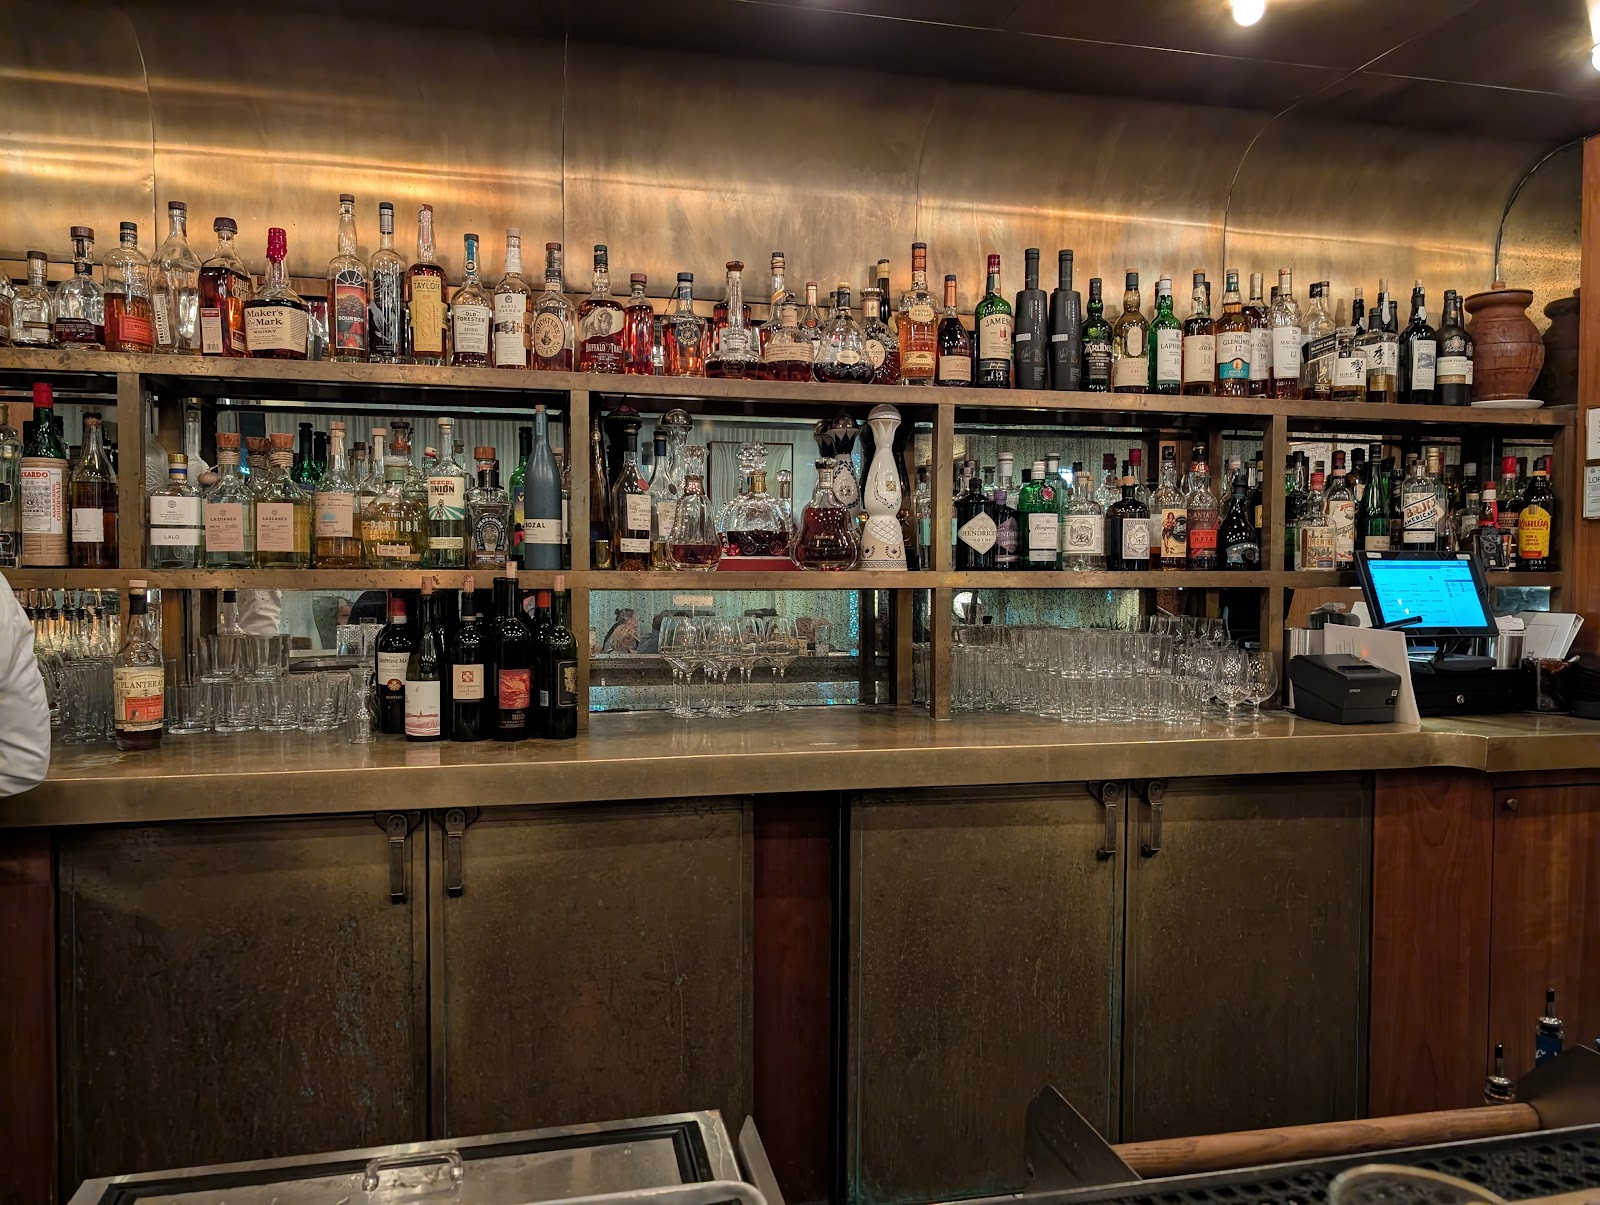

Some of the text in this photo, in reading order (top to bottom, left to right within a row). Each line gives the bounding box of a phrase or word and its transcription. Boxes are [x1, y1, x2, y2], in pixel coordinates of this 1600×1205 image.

[232, 274, 249, 290] ELIJAH
[414, 282, 440, 290] TAYLOR
[247, 309, 283, 317] Maker's
[256, 318, 282, 326] Mark
[536, 317, 561, 334] MICHTER'S
[679, 322, 698, 331] BLADE
[536, 340, 561, 355] BOURBON
[586, 343, 606, 352] BUFFALO
[1519, 518, 1549, 531] KAHLÚA
